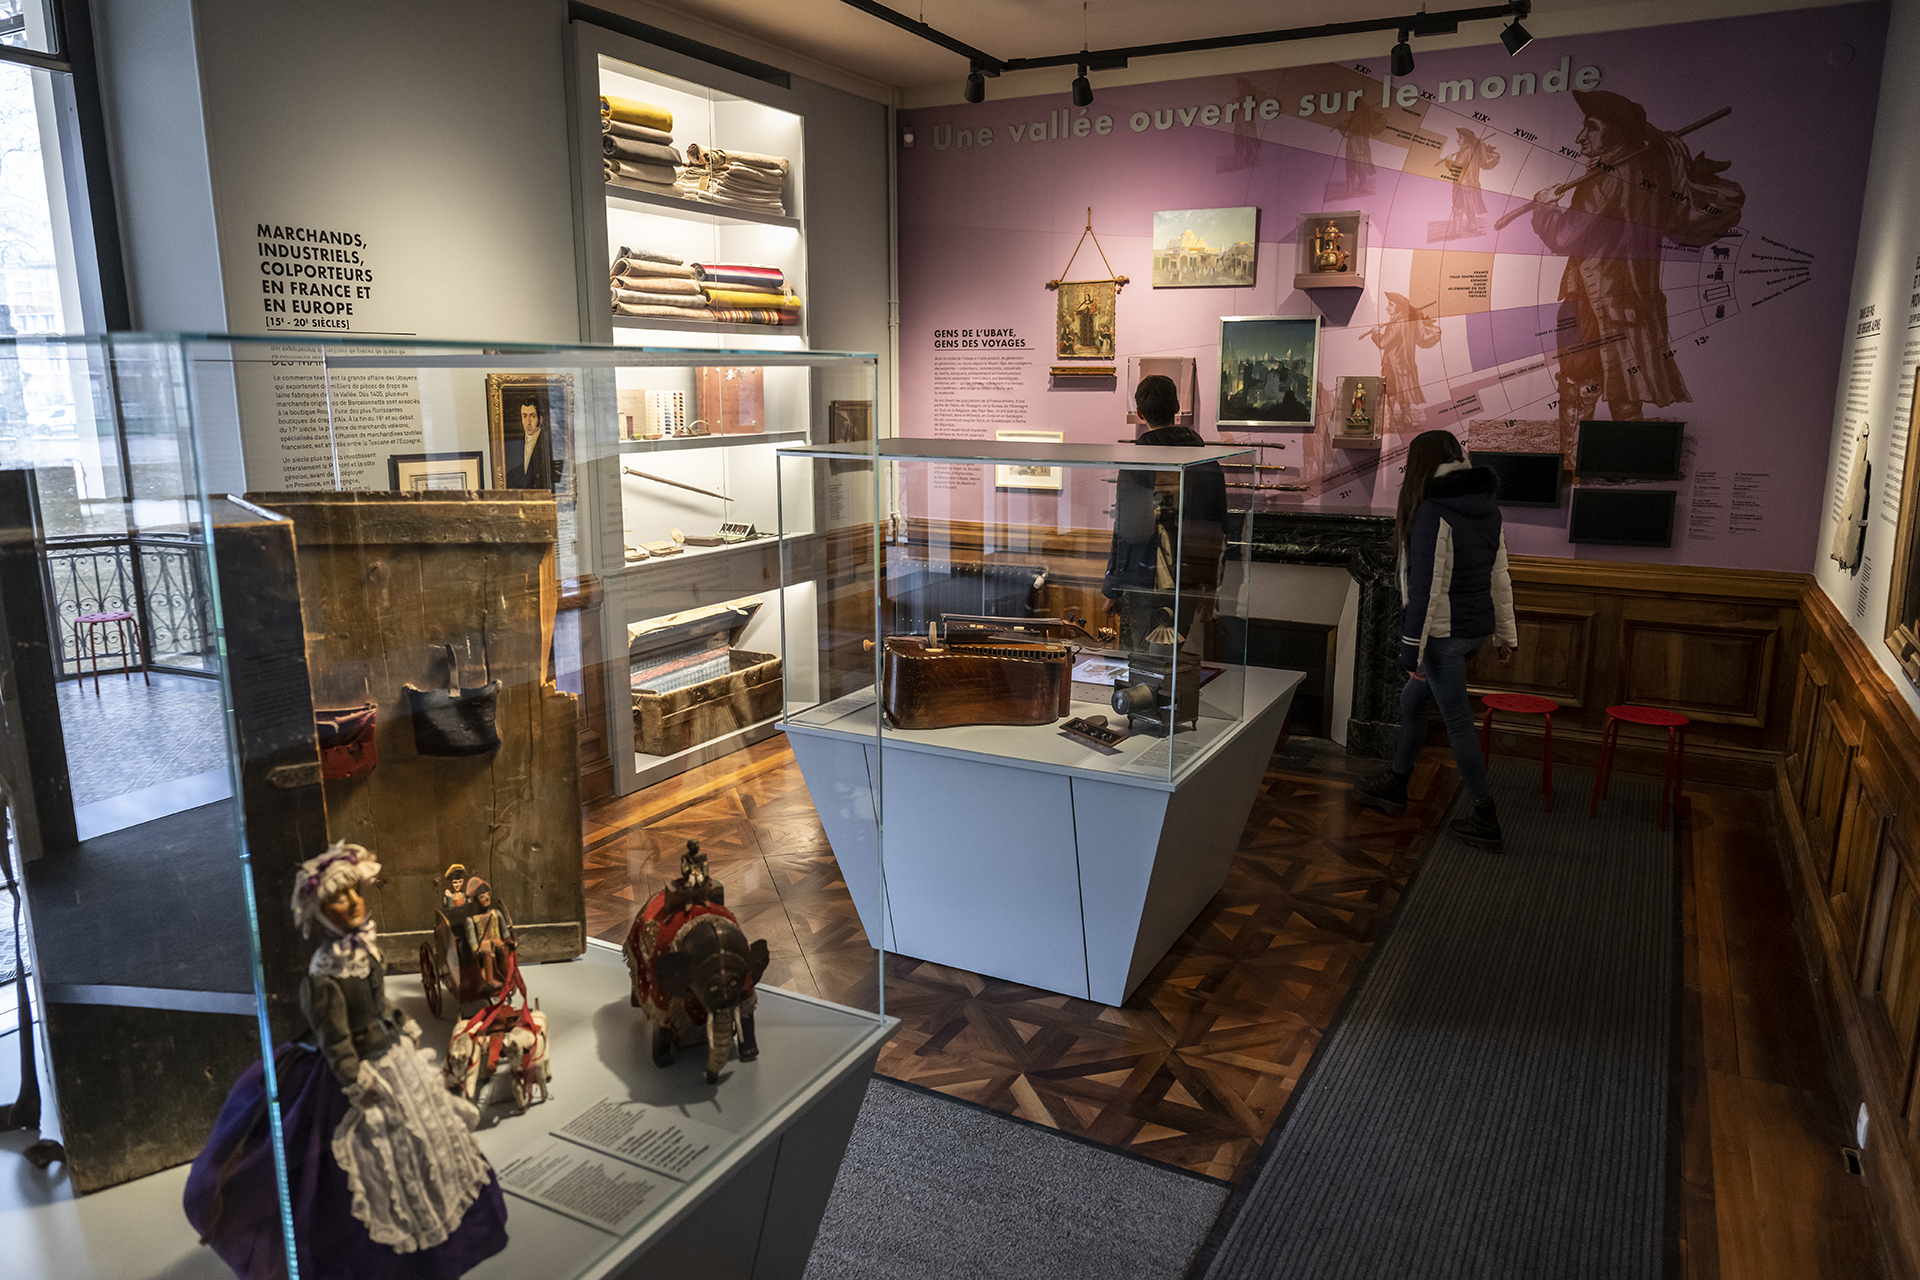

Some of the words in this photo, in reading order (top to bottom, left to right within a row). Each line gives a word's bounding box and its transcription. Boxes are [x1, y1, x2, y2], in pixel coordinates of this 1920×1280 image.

[932, 123, 994, 151] Une
[1007, 108, 1114, 143] vallée
[1129, 96, 1280, 132] ouverte
[1297, 89, 1363, 117] sur
[1381, 75, 1420, 109] le
[1438, 55, 1602, 104] monde
[256, 223, 368, 250] MARCHANDS,
[257, 242, 365, 267] INDUSTRIELS,
[260, 261, 374, 282] COLPORTEURS
[262, 279, 284, 294] EN
[290, 281, 352, 298] FRANCE
[356, 286, 371, 299] ET
[263, 298, 286, 313] EN
[292, 299, 354, 315] EUROPE
[312, 316, 350, 330] SIÈCLES]
[934, 329, 959, 338] GENS
[962, 329, 973, 338] DE
[976, 328, 1017, 338] L'UBAYE,
[934, 340, 959, 348] GENS
[962, 339, 979, 348] DES
[982, 339, 1026, 348] VOYAGES
[291, 391, 319, 399] fabriqués
[289, 409, 315, 417] boutique
[278, 418, 308, 426] boutiques
[299, 425, 318, 433] siècle,
[281, 443, 315, 451] françaises,
[292, 455, 310, 463] siècle
[310, 455, 323, 463] plus
[343, 452, 376, 460] investissent
[282, 463, 322, 472] littéralement
[364, 459, 376, 467] côte
[285, 473, 310, 482] génoise,
[294, 480, 322, 489] Provence,
